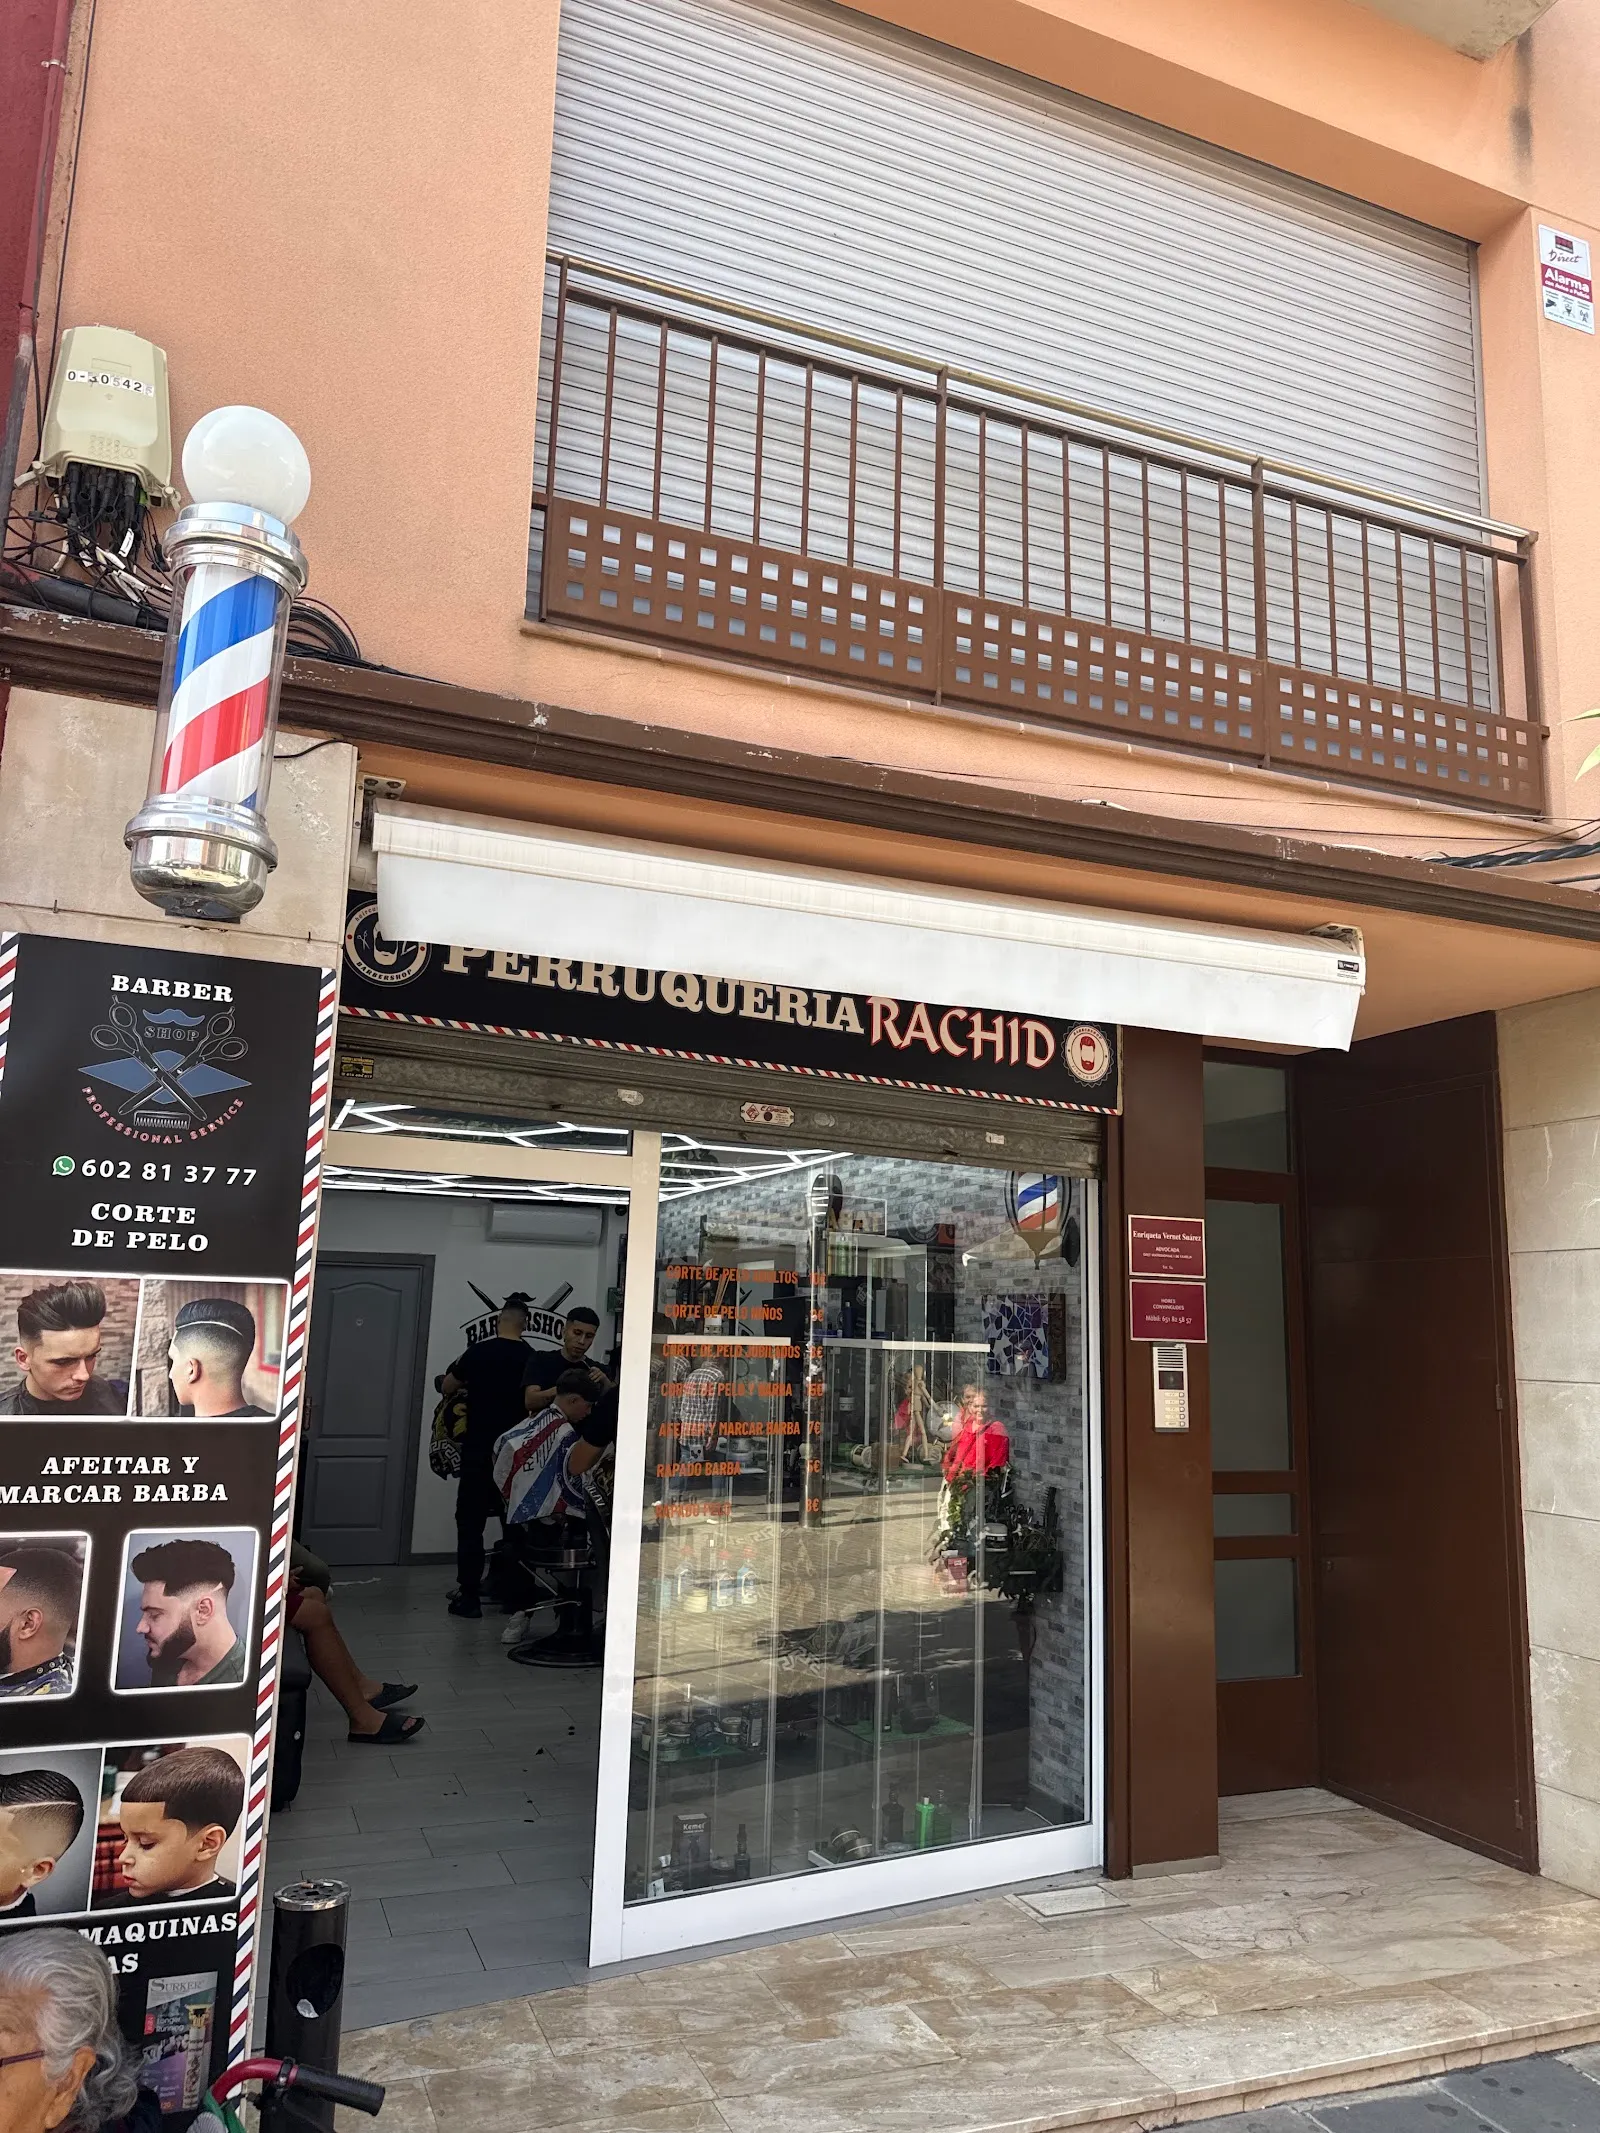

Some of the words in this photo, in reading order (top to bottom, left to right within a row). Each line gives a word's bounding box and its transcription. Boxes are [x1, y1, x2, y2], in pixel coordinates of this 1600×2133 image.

[1548, 249, 1583, 263] Direct
[1545, 268, 1590, 293] Alarma
[356, 961, 412, 981] BARBERSHOP
[111, 975, 234, 1003] BARBER
[443, 945, 864, 1034] PERRUQUERIA
[866, 996, 1056, 1069] RACHID
[144, 1025, 200, 1042] SHOP
[81, 1086, 182, 1144] PROFESSIONAL
[190, 1098, 243, 1140] SERVICE
[81, 1160, 131, 1179] 602
[141, 1163, 172, 1182] 81
[184, 1165, 216, 1184] 37
[226, 1168, 257, 1186] 77
[90, 1202, 196, 1224] CORTE
[71, 1229, 114, 1248] DE
[126, 1231, 209, 1252] PELO
[1132, 1230, 1161, 1240] Enriqueta
[1162, 1232, 1181, 1240] Vernet
[1182, 1233, 1201, 1242] Suárez
[666, 1265, 702, 1280] CORTE
[705, 1266, 720, 1281] DE
[722, 1267, 750, 1283] PELO
[752, 1269, 798, 1285] ADULTOS
[664, 1304, 701, 1319] CORTE
[704, 1305, 718, 1319] DE
[721, 1306, 748, 1320] PELO
[751, 1304, 783, 1321] NIÑOS
[465, 1311, 565, 1347] BARRSHO
[662, 1344, 698, 1358] CORTE
[700, 1344, 714, 1358] DE
[716, 1344, 743, 1358] PELO
[745, 1344, 800, 1359] JUBILADOS
[661, 1383, 697, 1397] CORTE
[700, 1383, 714, 1397] DE
[718, 1383, 745, 1397] PELO
[758, 1383, 793, 1397] BARBA
[659, 1422, 705, 1438] AFEITAR
[708, 1422, 715, 1436] Y
[719, 1421, 764, 1436] MARCAR
[766, 1421, 801, 1436] BARBA
[40, 1456, 170, 1475] AFEITAR
[182, 1456, 200, 1474] Y
[656, 1462, 702, 1478] RAPADO
[705, 1461, 742, 1477] BARBA
[0, 1485, 122, 1504] MARCAR
[133, 1483, 228, 1503] BARBA
[655, 1503, 700, 1518] RAPADO
[703, 1501, 732, 1517] PELO
[78, 1912, 238, 1947] MAQUINAS
[151, 1979, 201, 1993] SURKER
